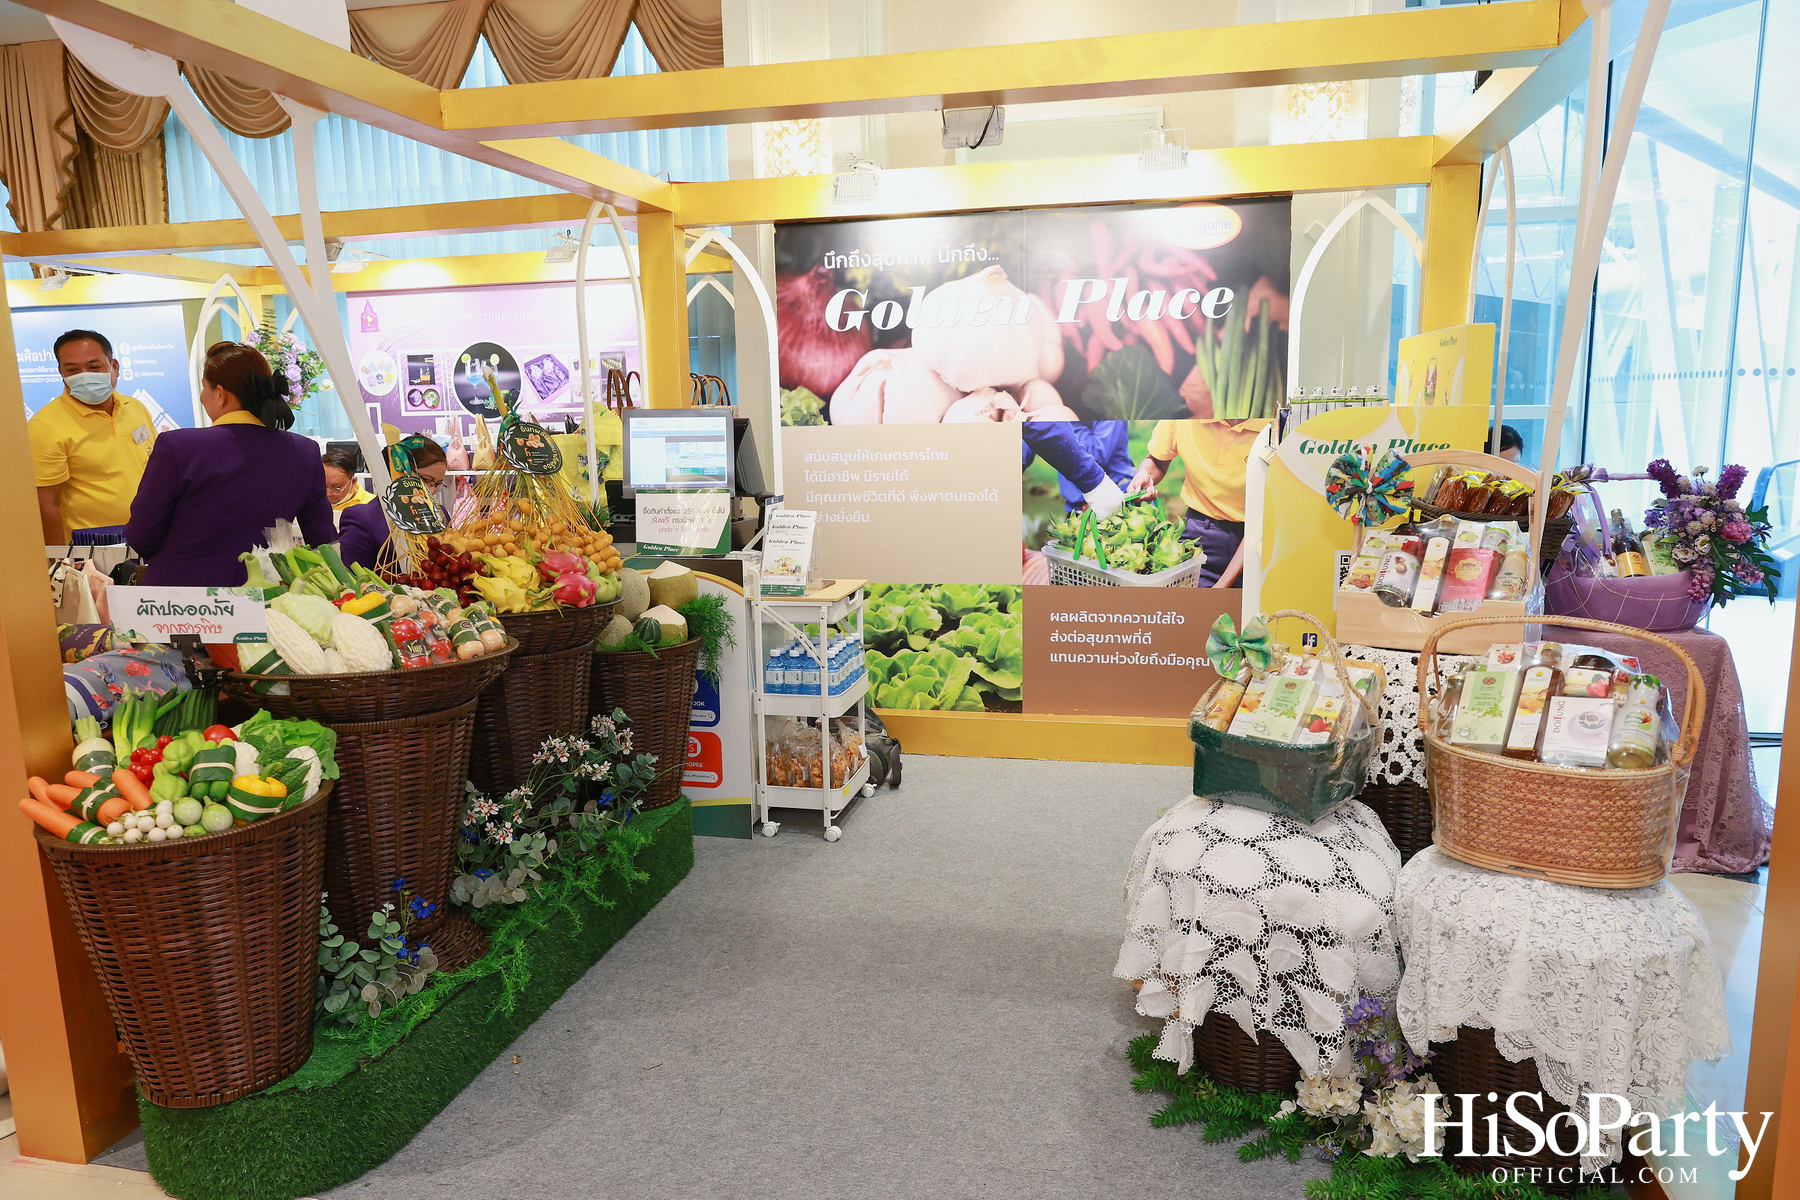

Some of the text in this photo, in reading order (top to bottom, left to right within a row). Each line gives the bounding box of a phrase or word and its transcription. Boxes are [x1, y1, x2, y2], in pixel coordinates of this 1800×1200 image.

[823, 242, 1000, 272] นึกถึงสุขภาพ นึกถึง...
[823, 277, 1235, 333] Golden Place
[804, 447, 949, 465] สนับสนุนให้เกษตรกรไทย
[804, 468, 909, 483] ได้มีอาชีพ มีรายได้
[805, 486, 999, 505] มีคุณภาพชีวิตที่ดี พึ่งพาตนเองได้
[814, 507, 870, 523] ย่างยั่งยืน
[136, 598, 235, 616] ผักปลอดภัย
[152, 618, 224, 634] จากสารพิษ
[1050, 610, 1185, 625] ผลผลิตจากความใส่ใจ
[1050, 629, 1152, 647] ส่งต่อสุขภาพที่ดี
[1050, 651, 1210, 670] แทนความห่วงใยถึงมือคุณ
